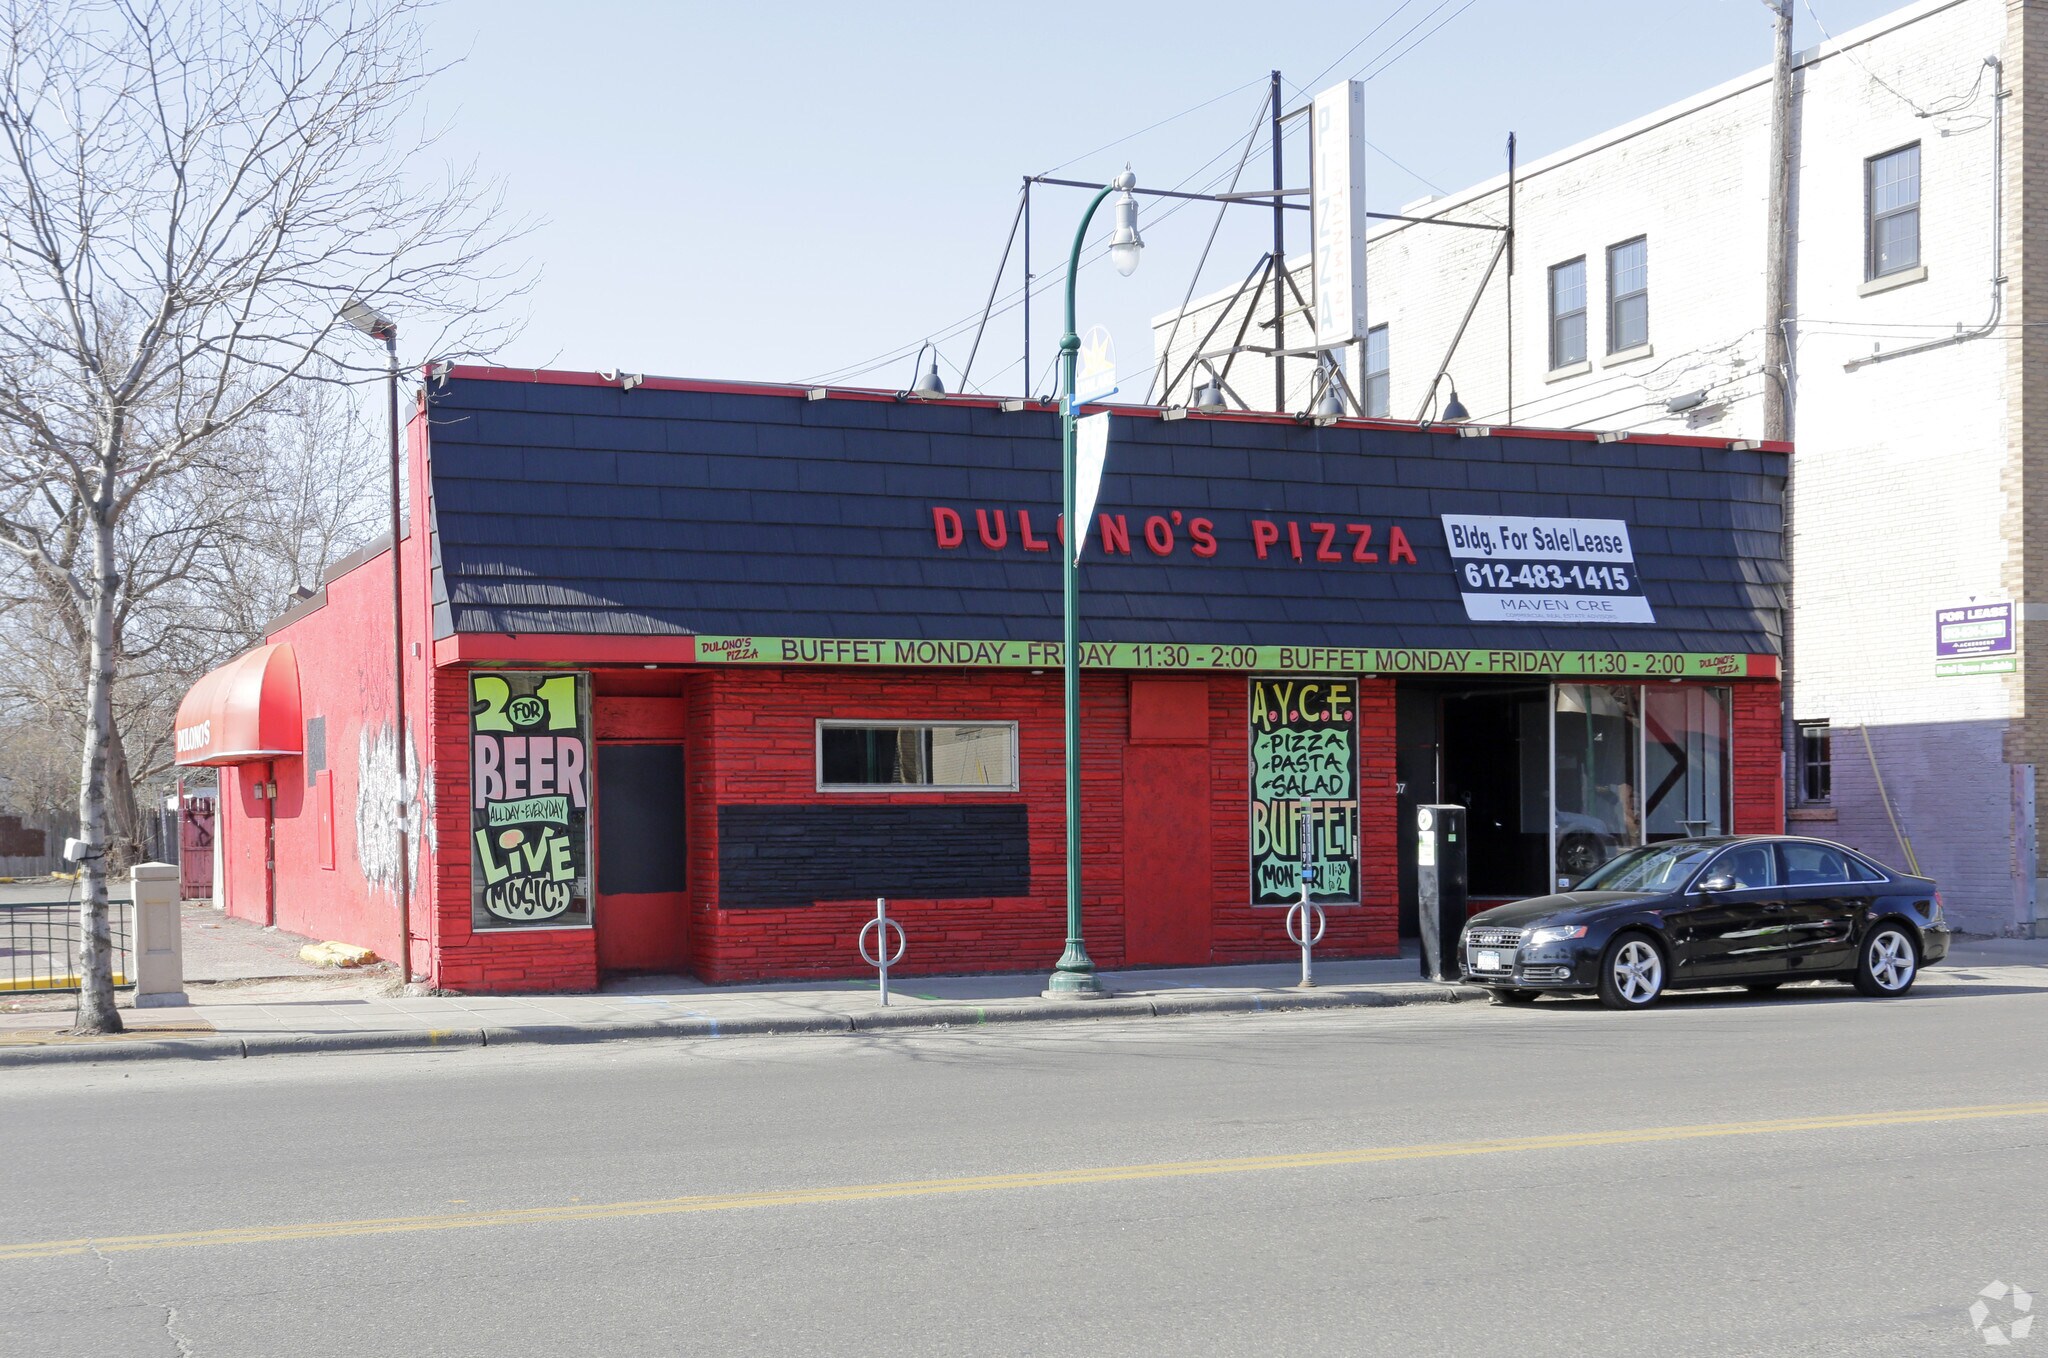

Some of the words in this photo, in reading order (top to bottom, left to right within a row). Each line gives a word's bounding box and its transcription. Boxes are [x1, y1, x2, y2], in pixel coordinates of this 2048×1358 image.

[1318, 105, 1333, 331] PIZZA
[932, 506, 1217, 558] DULNO'S
[1251, 519, 1417, 565] PIZZA
[1451, 524, 1497, 556] Bldg.
[1499, 525, 1528, 551] For
[1533, 526, 1623, 553] Sale/Lease
[1465, 562, 1629, 591] 612-483-1415
[1501, 599, 1569, 611] MAVEN
[1576, 600, 1614, 611] CRE
[1939, 611, 1965, 622] FOR
[1967, 606, 2008, 619] LEASE
[701, 637, 752, 653] DULONO'S
[727, 648, 758, 661] PIZZA
[781, 639, 885, 662] BUFFET
[894, 641, 1006, 664] MONDAY
[1132, 645, 1189, 667] 11:30
[1211, 646, 1257, 668] 2:00
[1280, 648, 1368, 670] BUFFET
[1375, 650, 1471, 672] MONDAY
[1489, 652, 1565, 673] FRIDAY
[1577, 653, 1627, 673] 11:30
[1645, 654, 1684, 674] 2:00
[1717, 664, 1739, 675] PIZZA
[473, 676, 514, 732] 2
[513, 701, 541, 720] FOR
[536, 675, 577, 731] 1
[1270, 733, 1344, 753] PIZZA
[474, 735, 586, 808] BEER
[1270, 753, 1344, 773] PASTA
[1271, 774, 1343, 797] SALAD
[1252, 800, 1356, 856] BUFFET
[1262, 864, 1324, 889] MON-RI
[1328, 863, 1346, 876] 11:30
[1337, 877, 1345, 891] 2
[490, 875, 564, 916] MUSIC!
